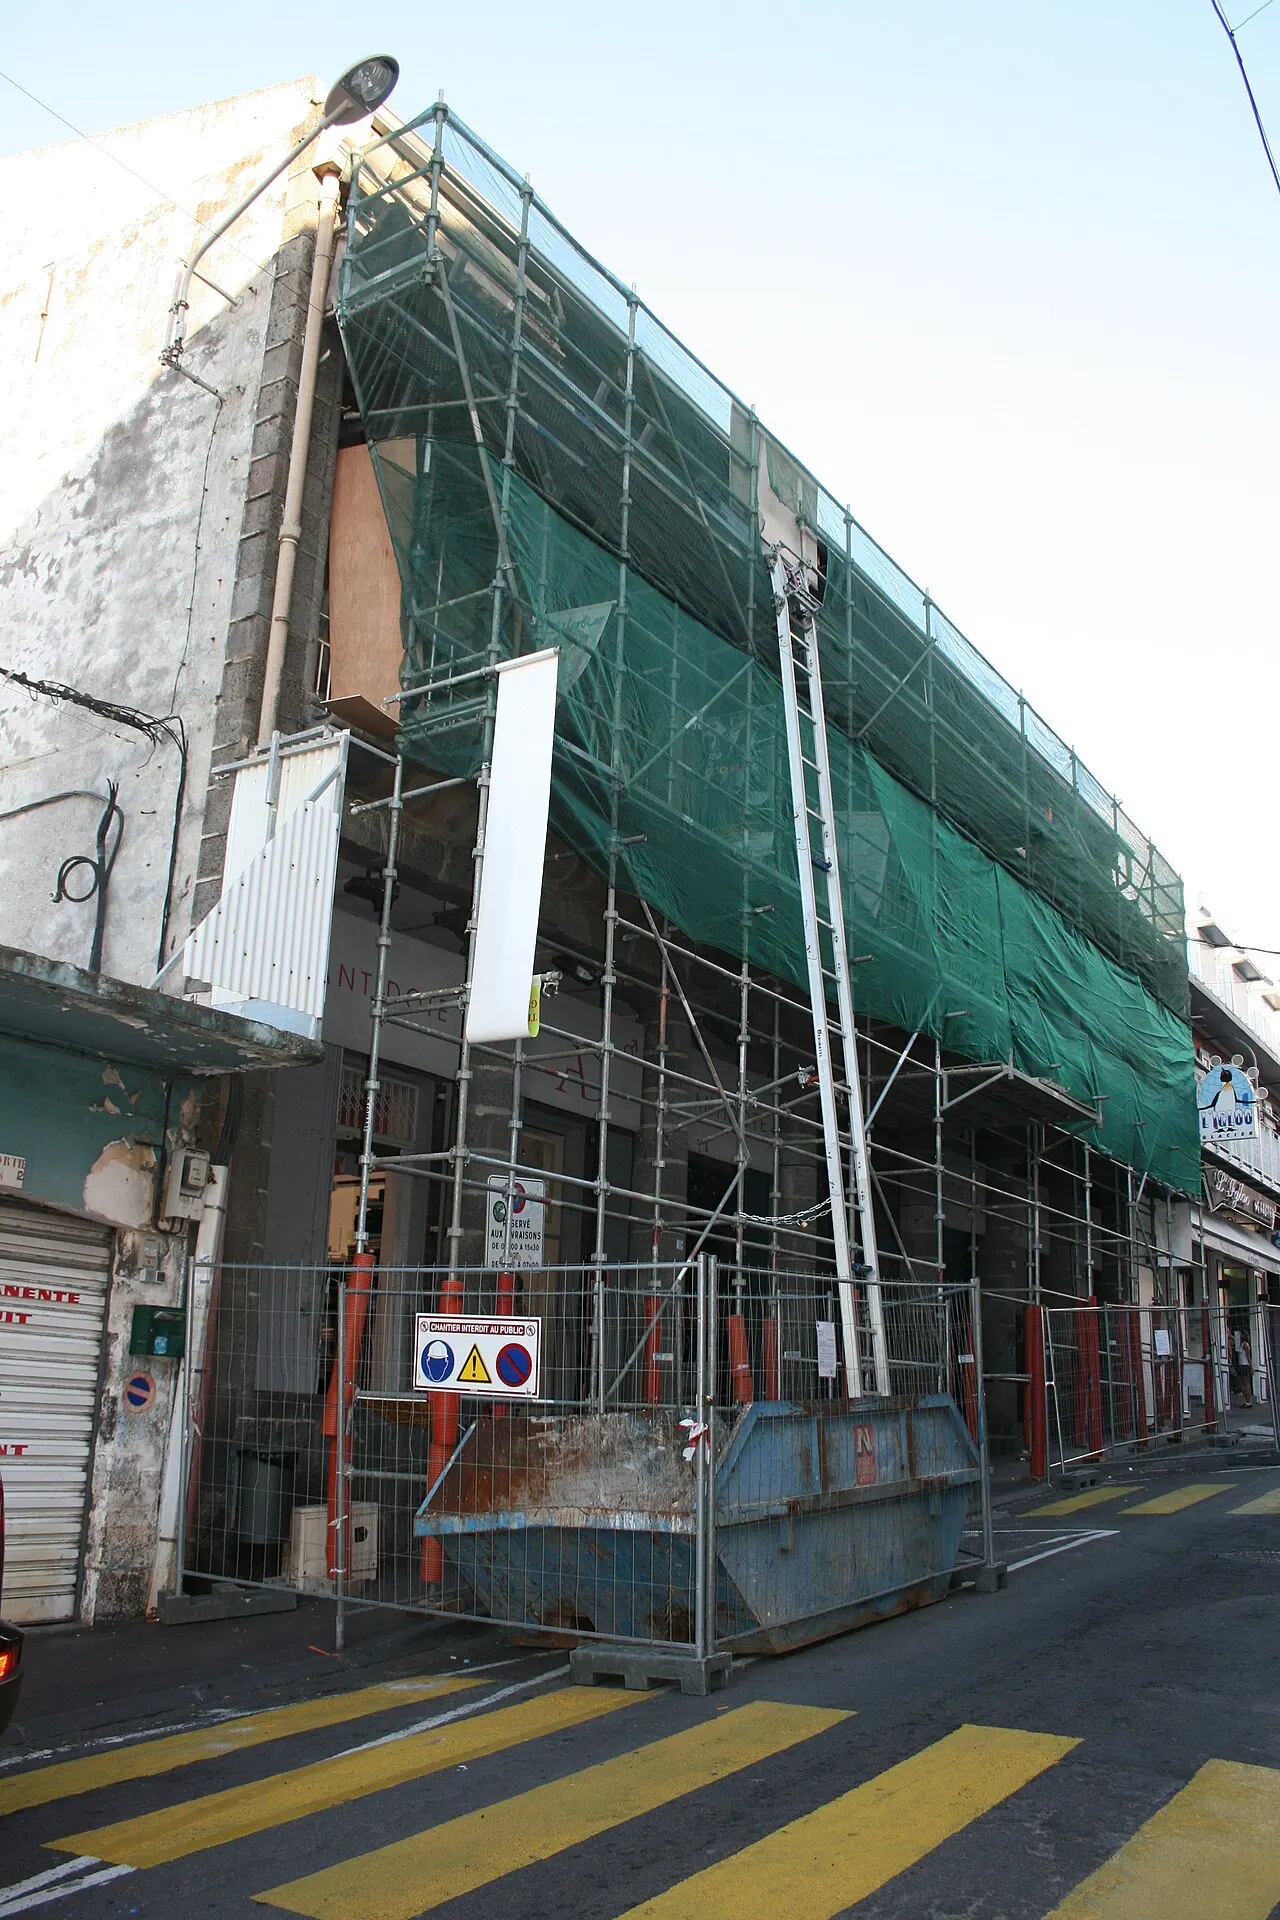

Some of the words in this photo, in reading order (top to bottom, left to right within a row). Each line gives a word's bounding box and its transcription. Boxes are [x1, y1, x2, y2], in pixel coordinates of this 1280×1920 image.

[502, 1219, 531, 1229] RSERVÉ
[491, 1229, 504, 1239] AUX
[509, 1230, 541, 1240] VRAISONS
[430, 1322, 460, 1332] CHANTIER
[461, 1324, 489, 1334] INTERDIT
[490, 1325, 499, 1334] AU
[500, 1325, 524, 1335] PUBLIC
